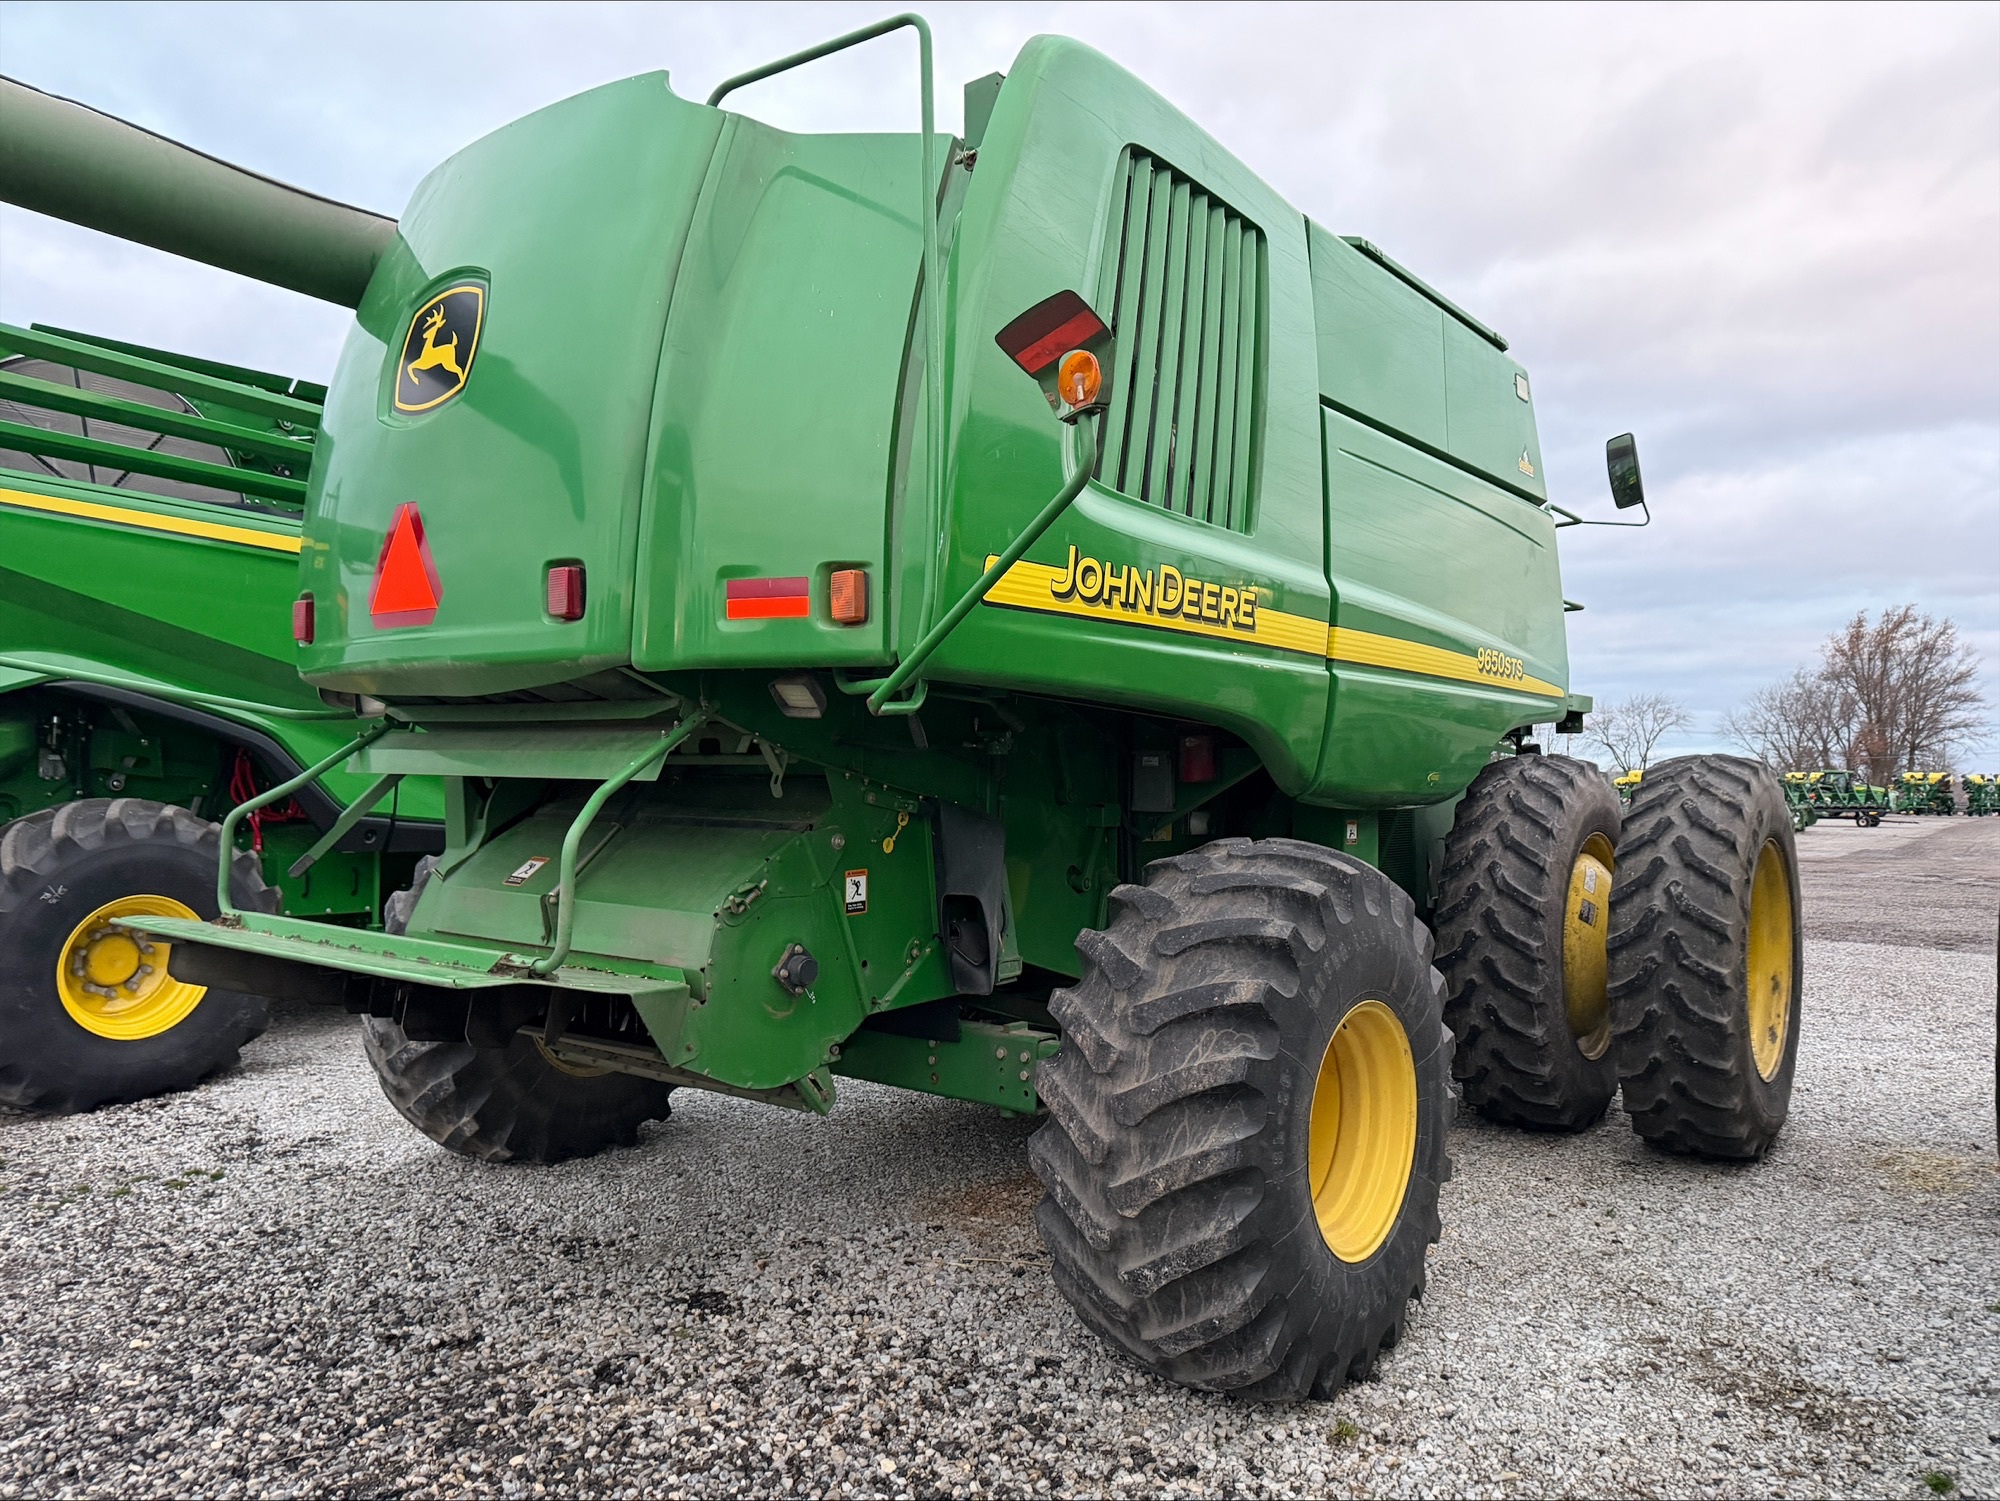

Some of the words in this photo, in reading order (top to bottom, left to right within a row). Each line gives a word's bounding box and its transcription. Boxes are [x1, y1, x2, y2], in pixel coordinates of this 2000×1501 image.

[1050, 544, 1154, 613] JOHN
[1156, 563, 1257, 632] DEERE
[1477, 646, 1524, 680] 9650STS
